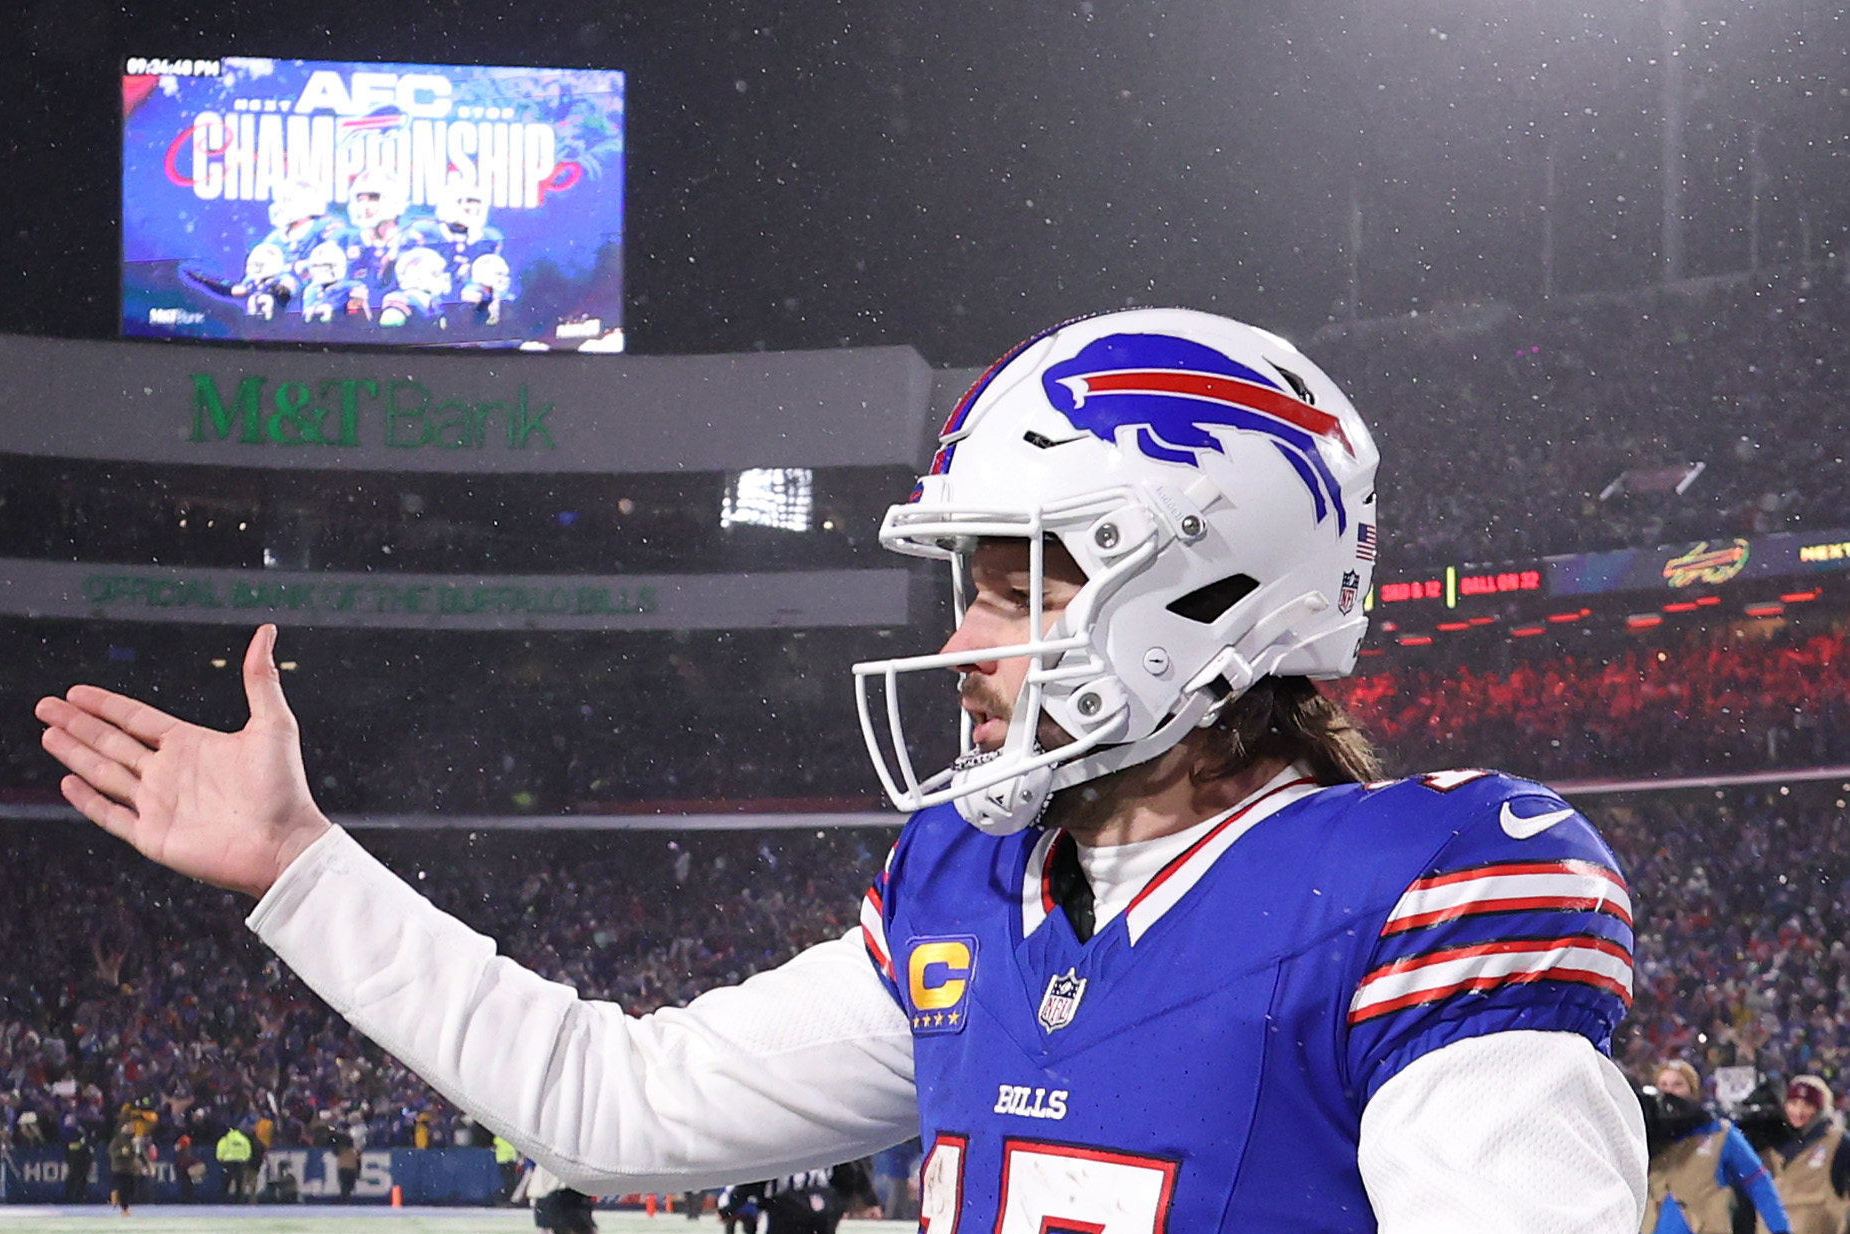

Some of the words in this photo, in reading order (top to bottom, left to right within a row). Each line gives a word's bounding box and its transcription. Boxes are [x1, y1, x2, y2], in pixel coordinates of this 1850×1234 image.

[194, 59, 220, 77] PM
[234, 98, 292, 113] NEXT
[293, 70, 452, 118] AFC
[457, 105, 515, 121] STOP
[192, 110, 556, 211] CHAMPIONSHIP
[188, 372, 379, 447] M&T
[386, 379, 556, 449] Bank
[81, 574, 222, 607] OFFICIAL
[230, 579, 315, 609] BANK
[320, 583, 365, 612] OF
[364, 582, 430, 613] THE
[435, 585, 570, 615] BUFFALO
[574, 585, 658, 616] BILLS
[1460, 575, 1497, 596] BALL
[1497, 573, 1520, 591] ON
[908, 941, 971, 1011] C
[1043, 997, 1072, 1024] NFL
[993, 1083, 1069, 1121] BILLS
[22, 1159, 99, 1184] HO
